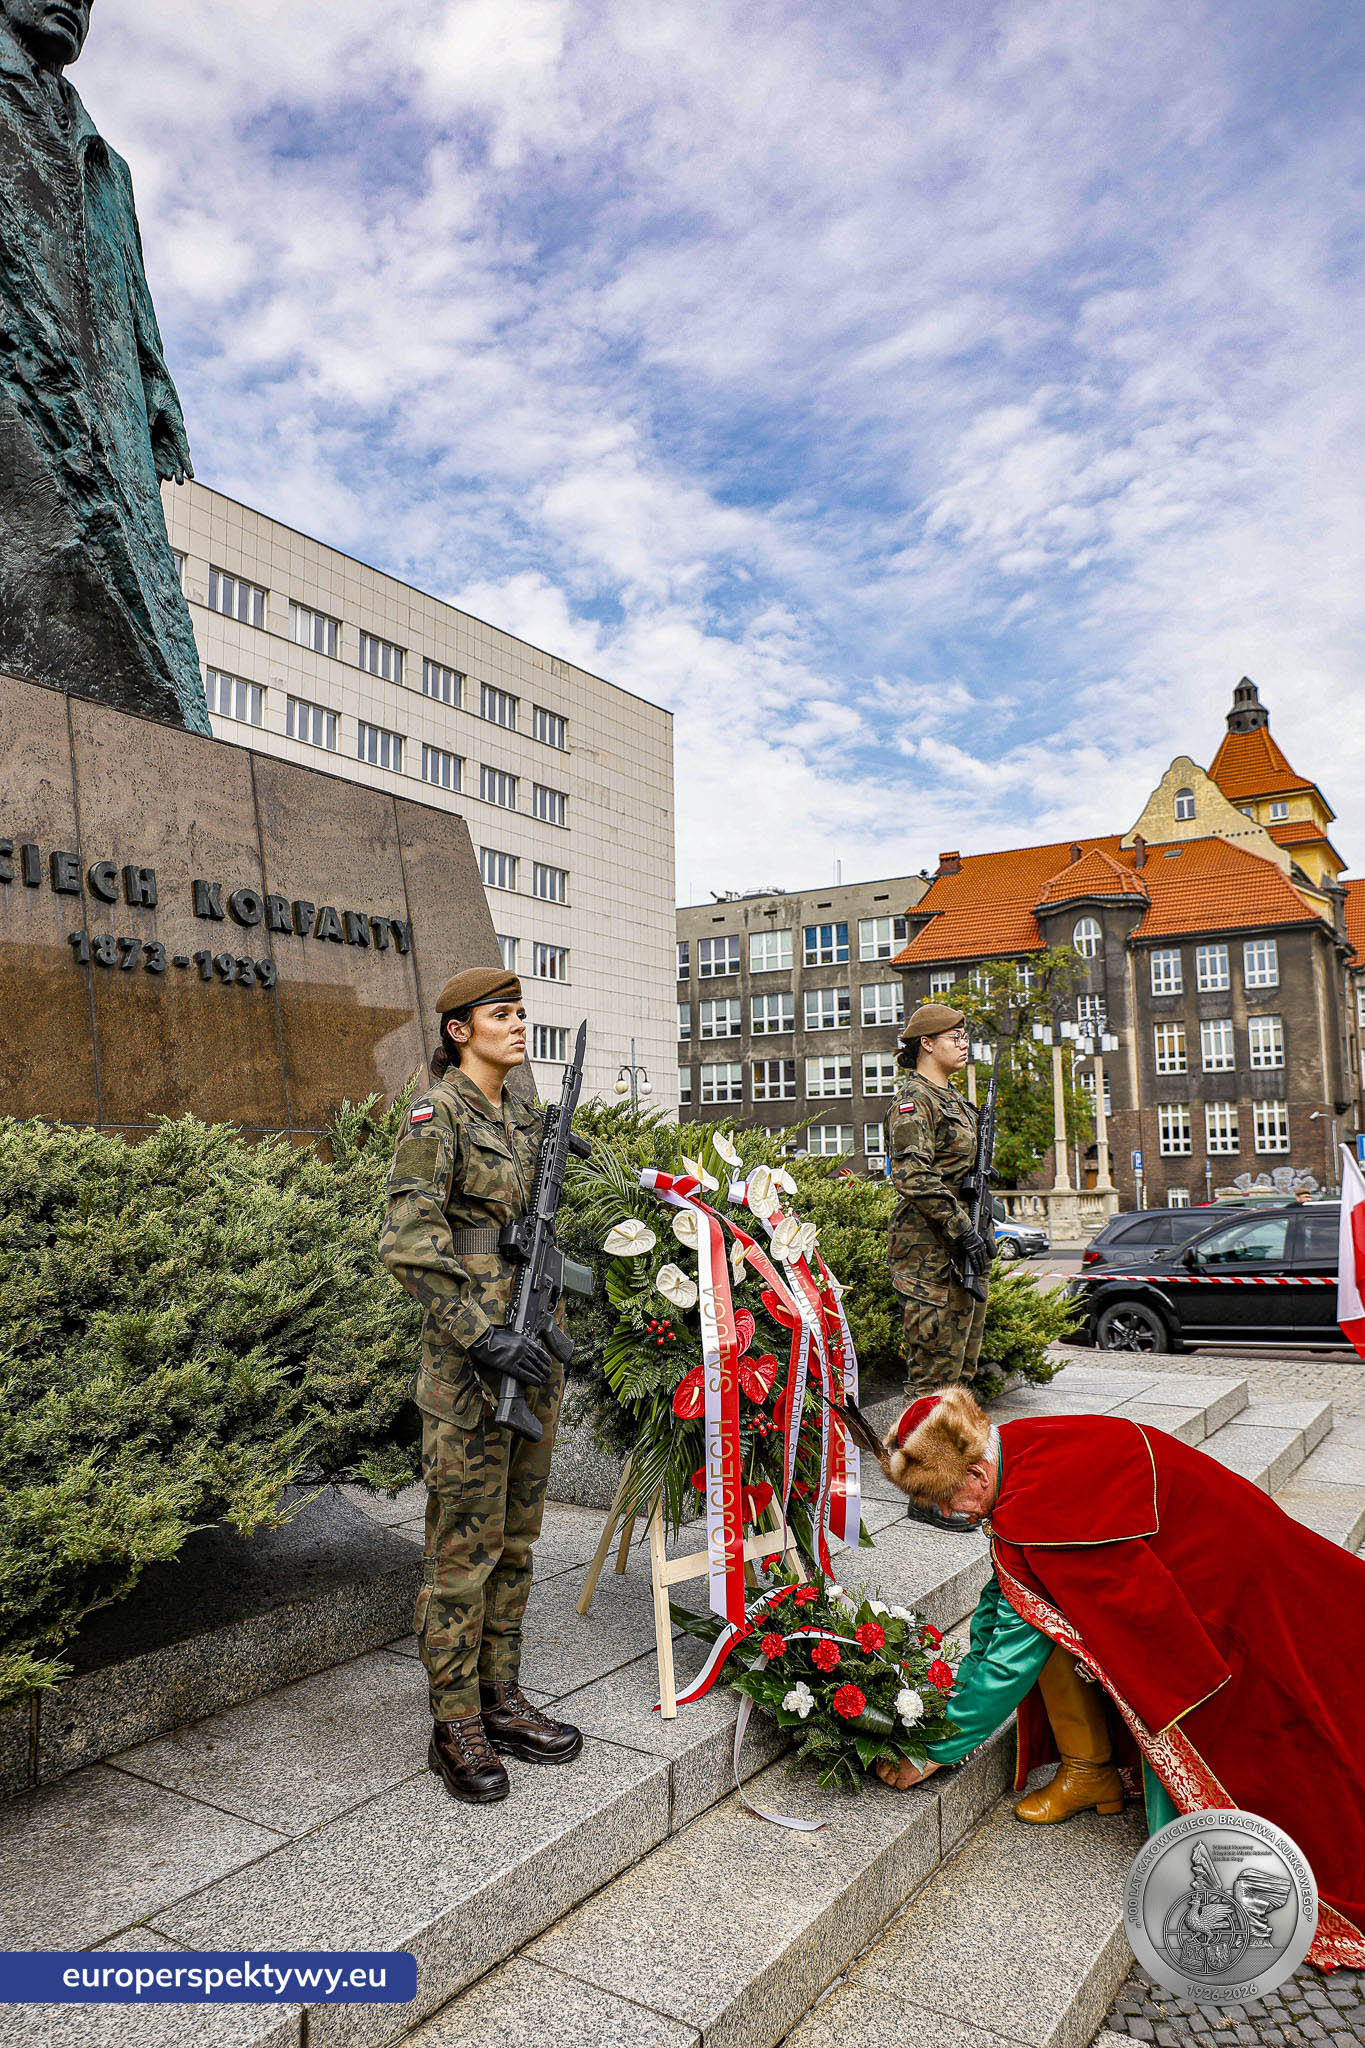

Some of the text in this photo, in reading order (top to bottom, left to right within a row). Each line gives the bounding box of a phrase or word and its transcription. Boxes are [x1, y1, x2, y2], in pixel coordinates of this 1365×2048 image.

[68, 930, 277, 990] 1873-1939
[192, 879, 413, 955] KORFANTY
[783, 1262, 832, 1382] KORFANTEM
[703, 1283, 736, 1577] WOJCIECH SAŁUGA
